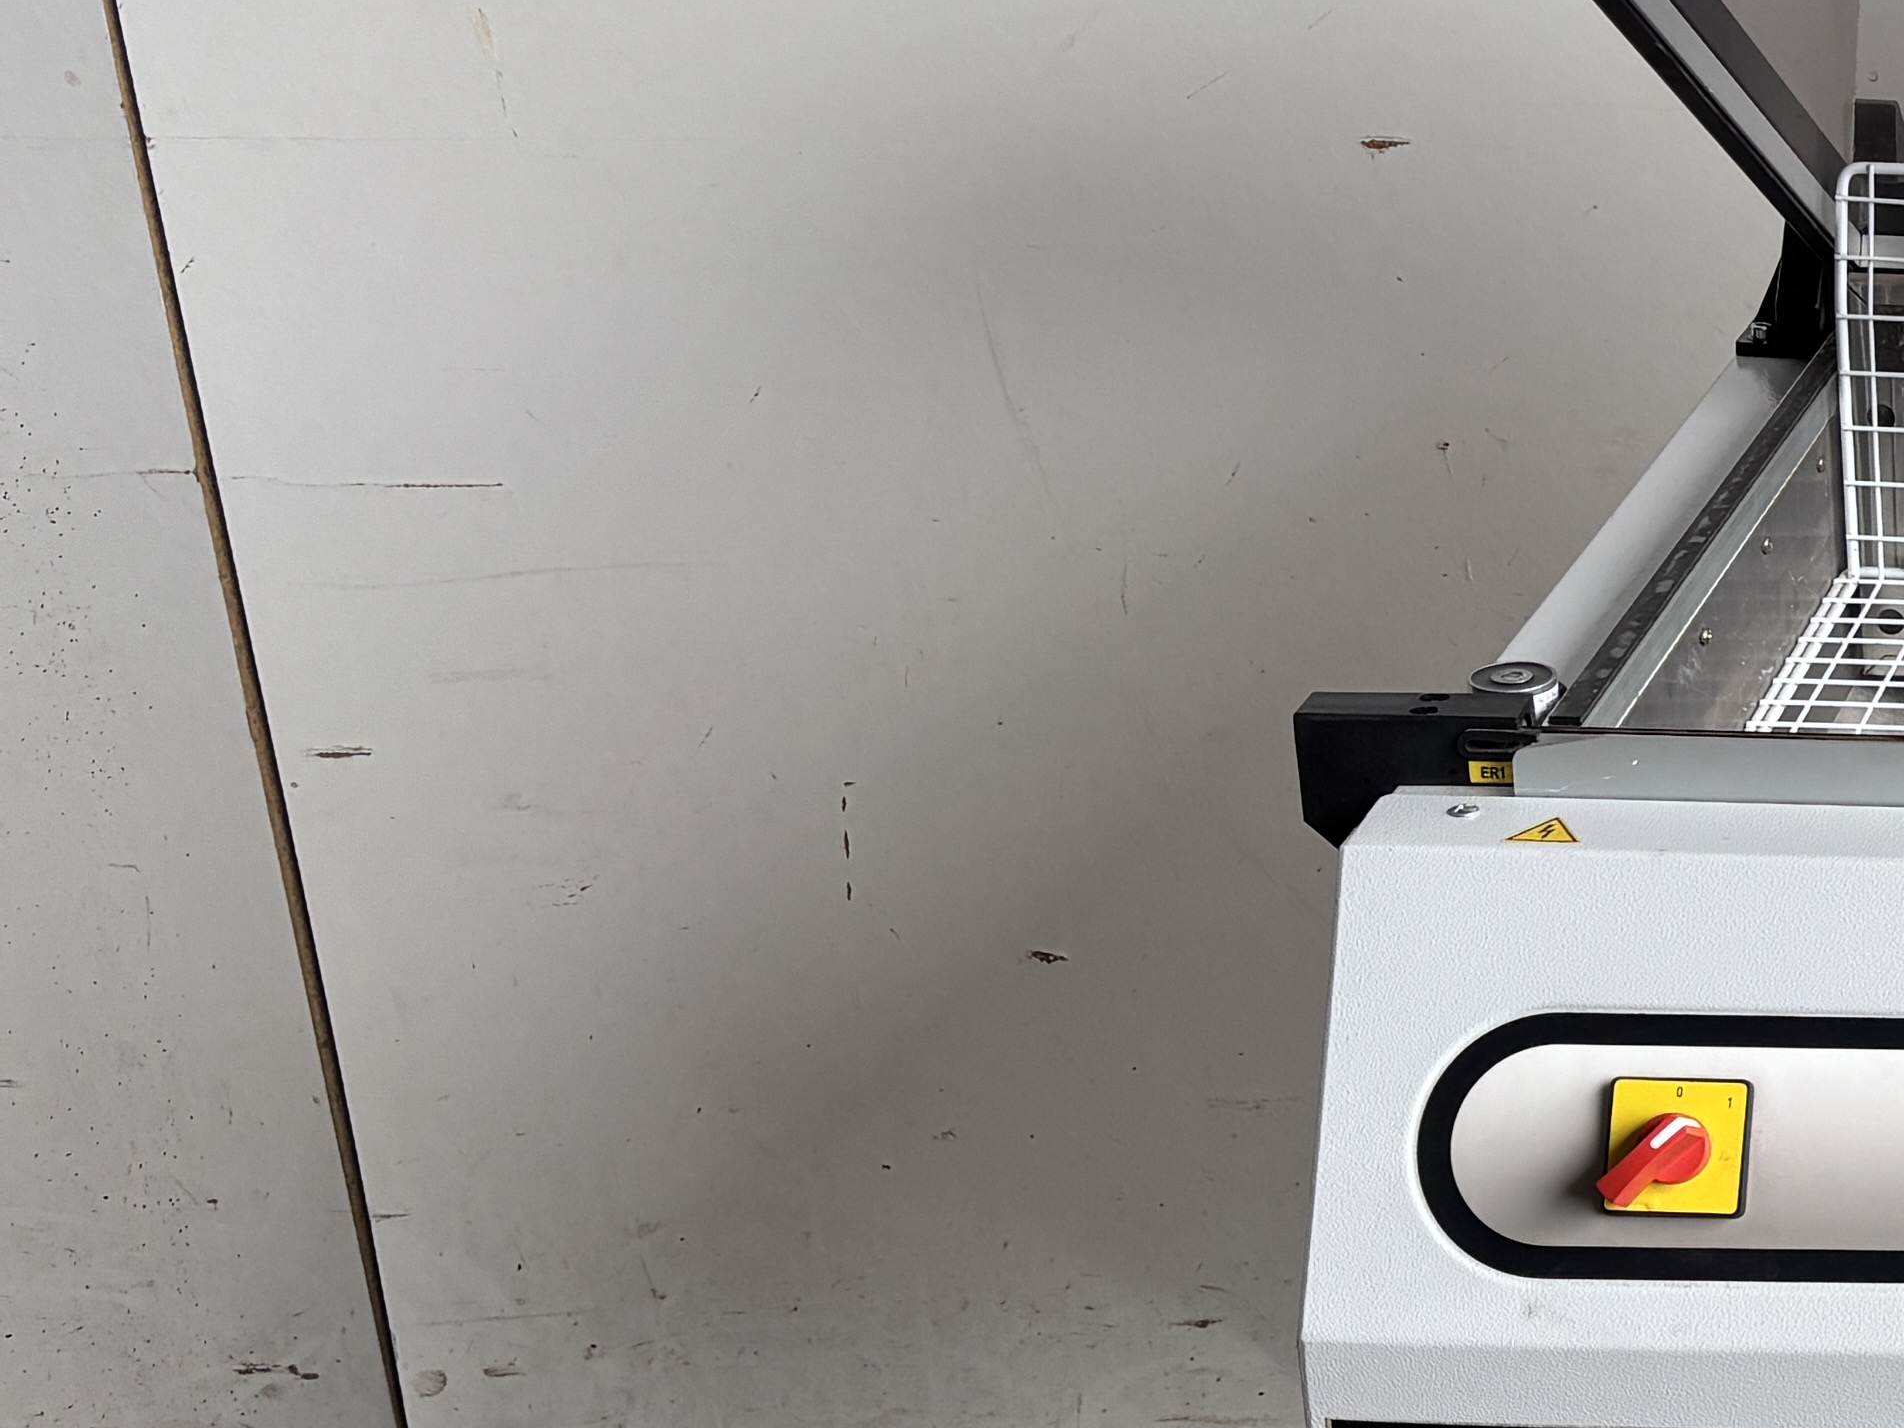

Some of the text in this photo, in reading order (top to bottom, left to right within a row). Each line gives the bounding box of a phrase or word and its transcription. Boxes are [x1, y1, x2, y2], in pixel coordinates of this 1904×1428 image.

[1480, 766, 1506, 780] ER1
[1676, 1086, 1684, 1098] 0
[1727, 1097, 1733, 1109] 1
